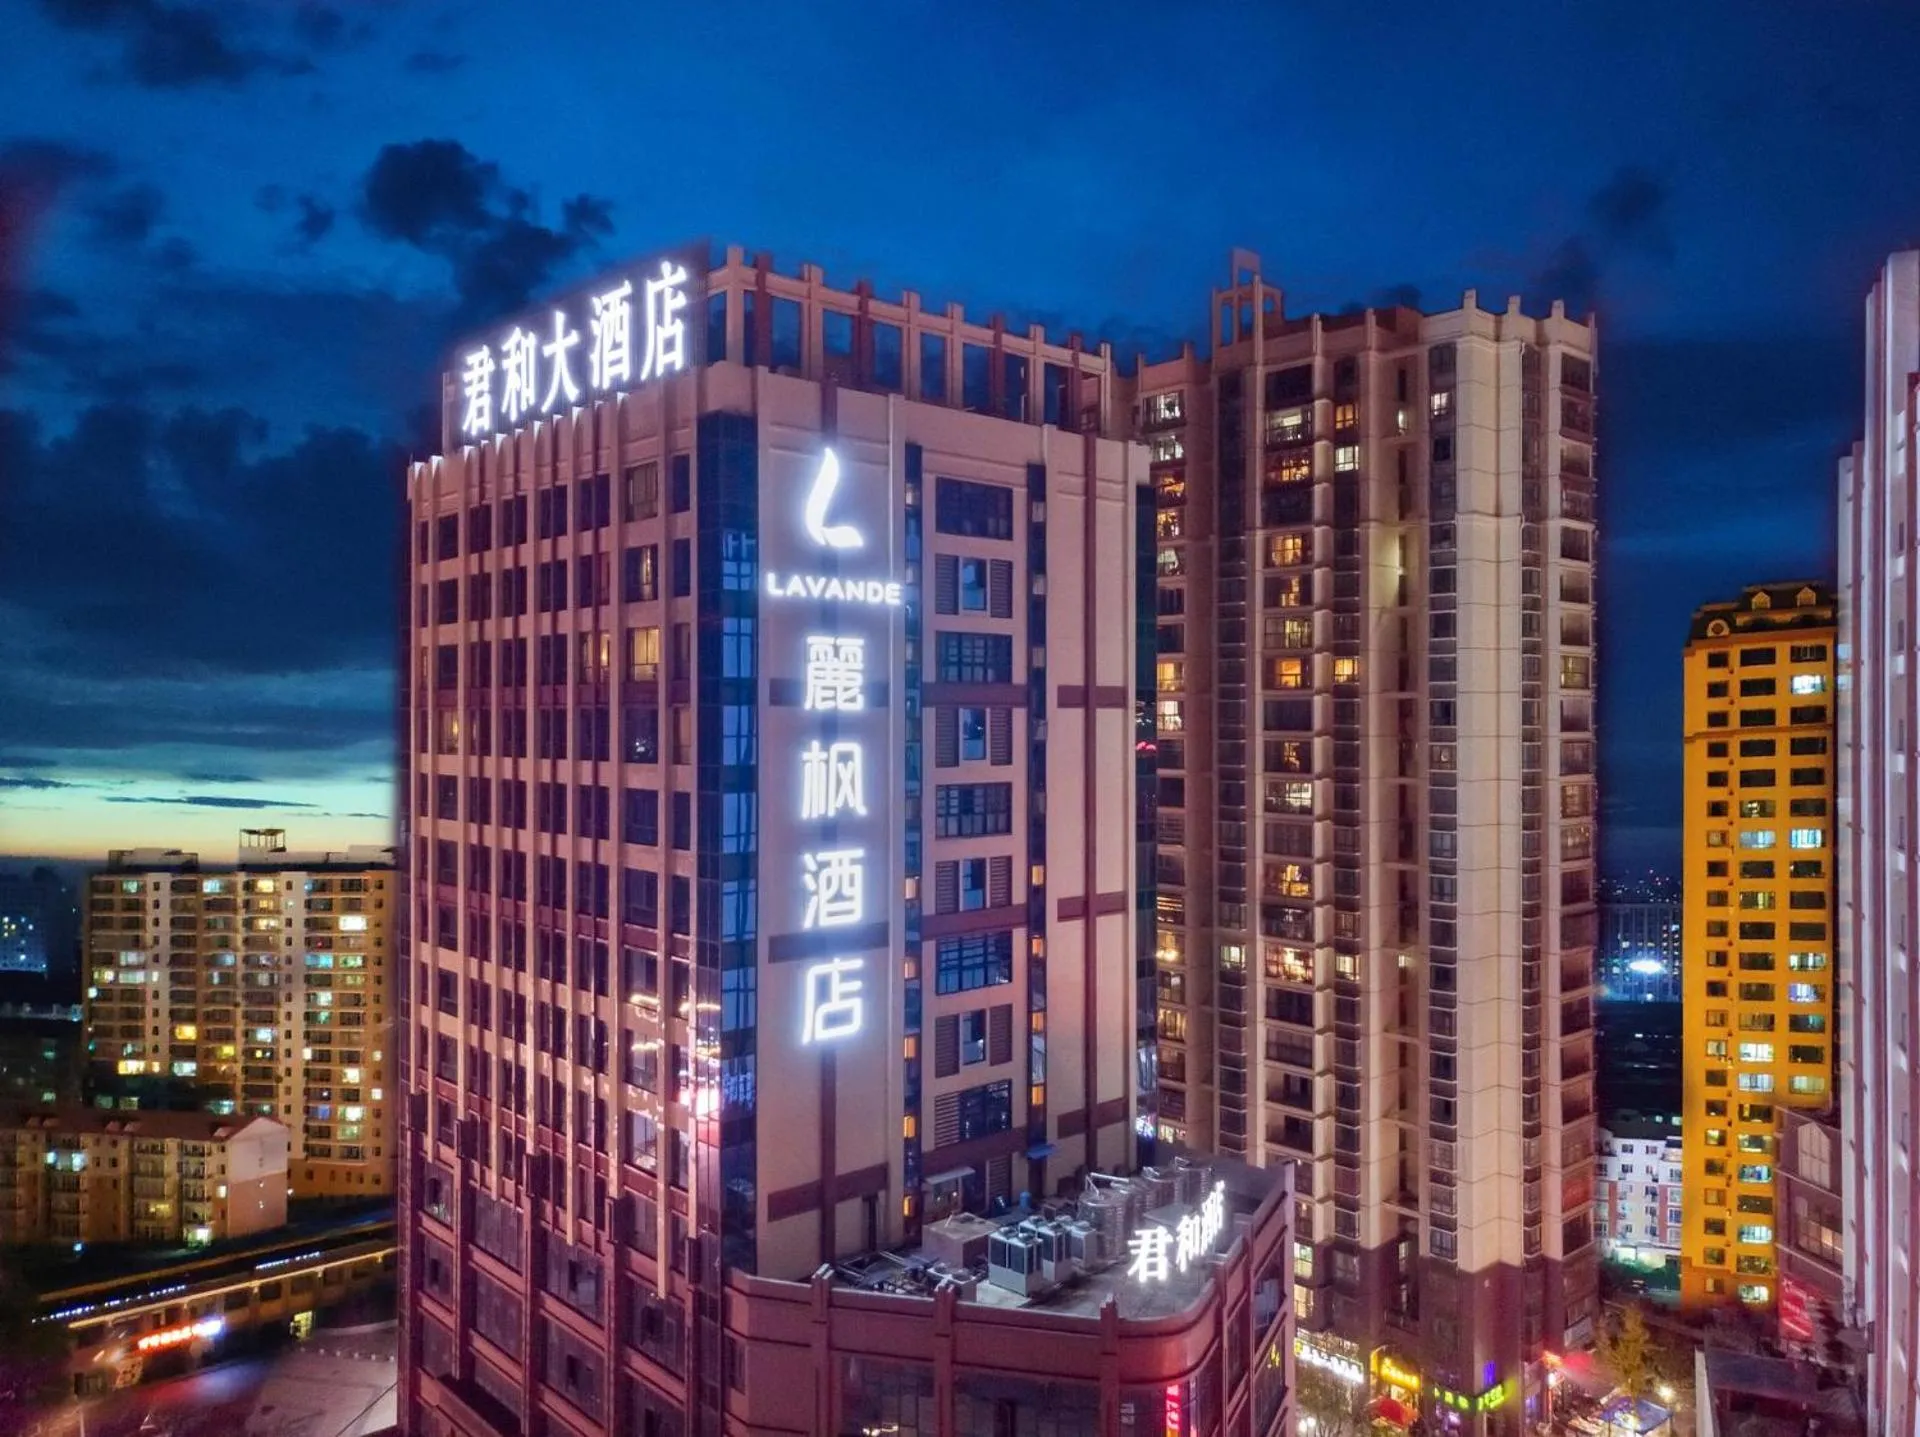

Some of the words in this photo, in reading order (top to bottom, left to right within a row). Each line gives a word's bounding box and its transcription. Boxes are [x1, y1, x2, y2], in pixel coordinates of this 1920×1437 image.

[463, 261, 687, 436] 君和大酒店
[767, 572, 903, 605] LAVANDE
[801, 635, 867, 1044] 麗枫酒店
